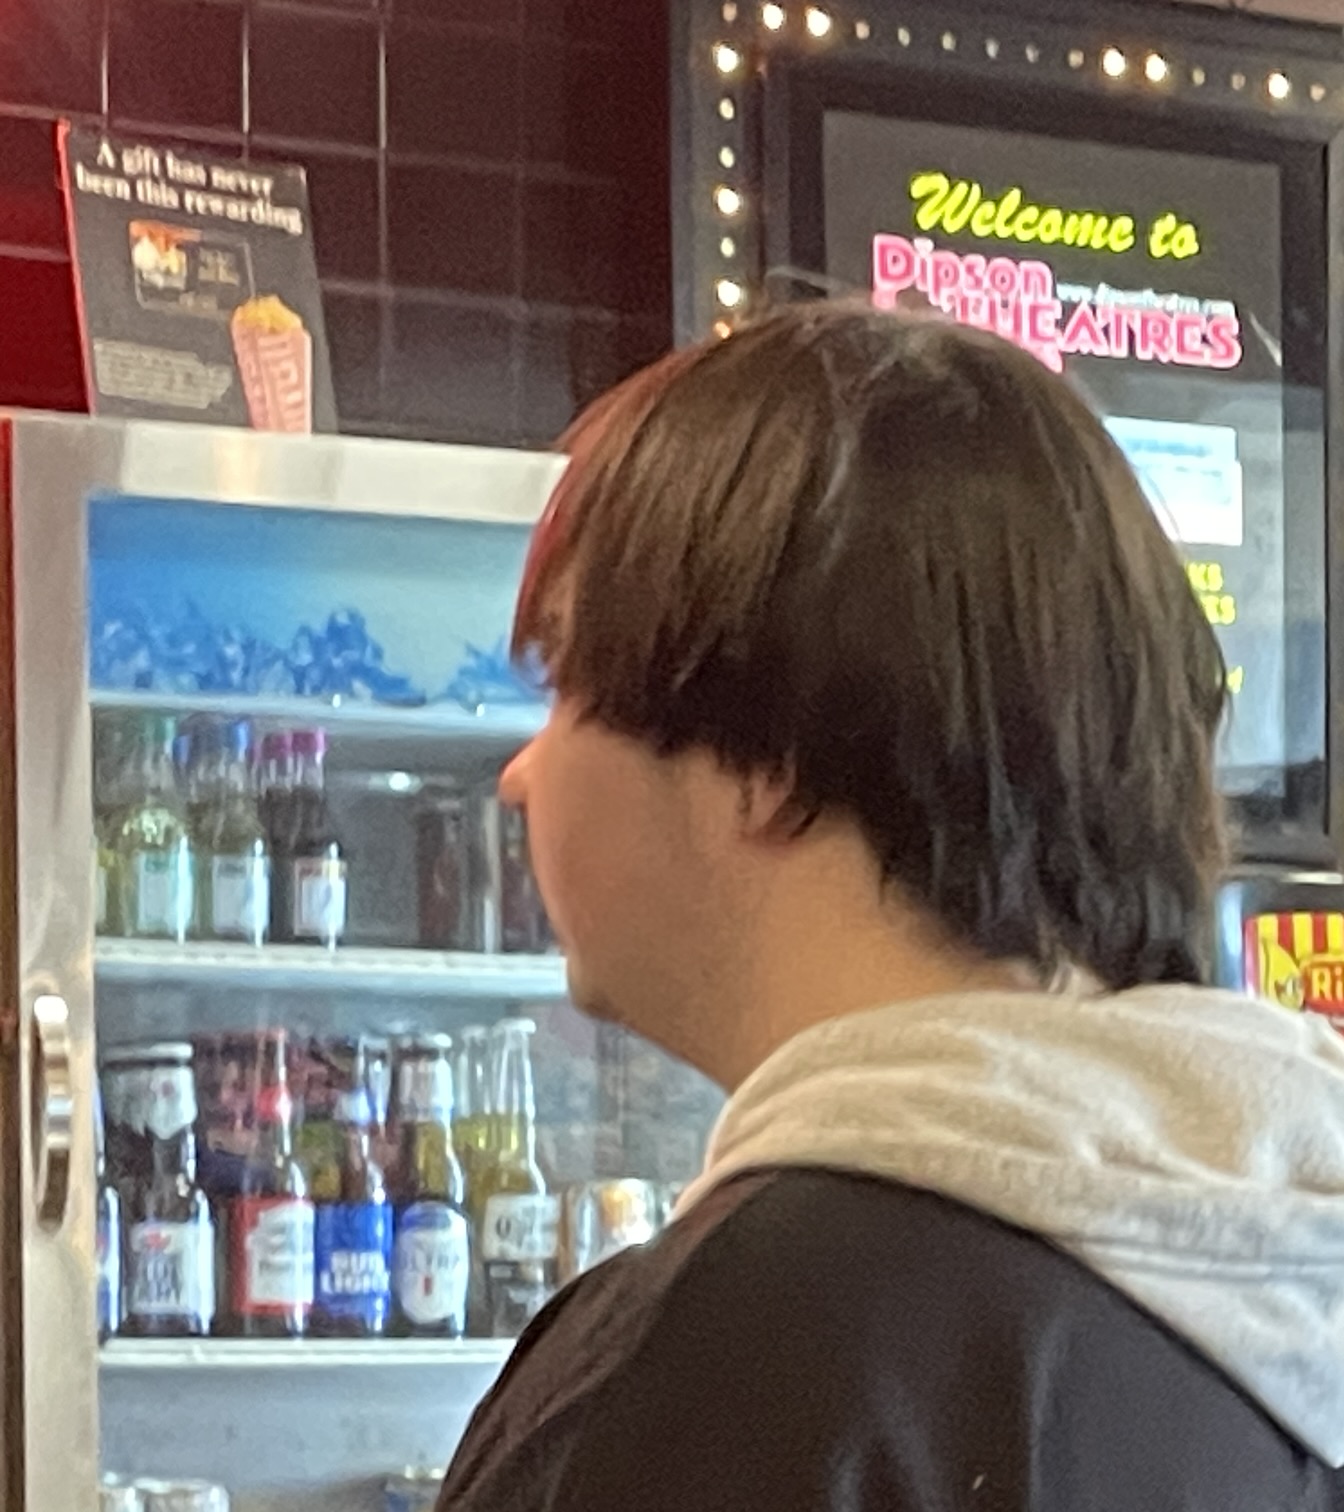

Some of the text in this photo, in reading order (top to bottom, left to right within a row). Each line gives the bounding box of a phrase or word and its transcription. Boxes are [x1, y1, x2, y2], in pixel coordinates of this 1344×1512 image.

[97, 139, 115, 168] A
[122, 145, 160, 177] gift
[75, 161, 302, 235] been this rewarding
[910, 172, 1200, 260] Welcome to
[873, 233, 1053, 308] Dipson
